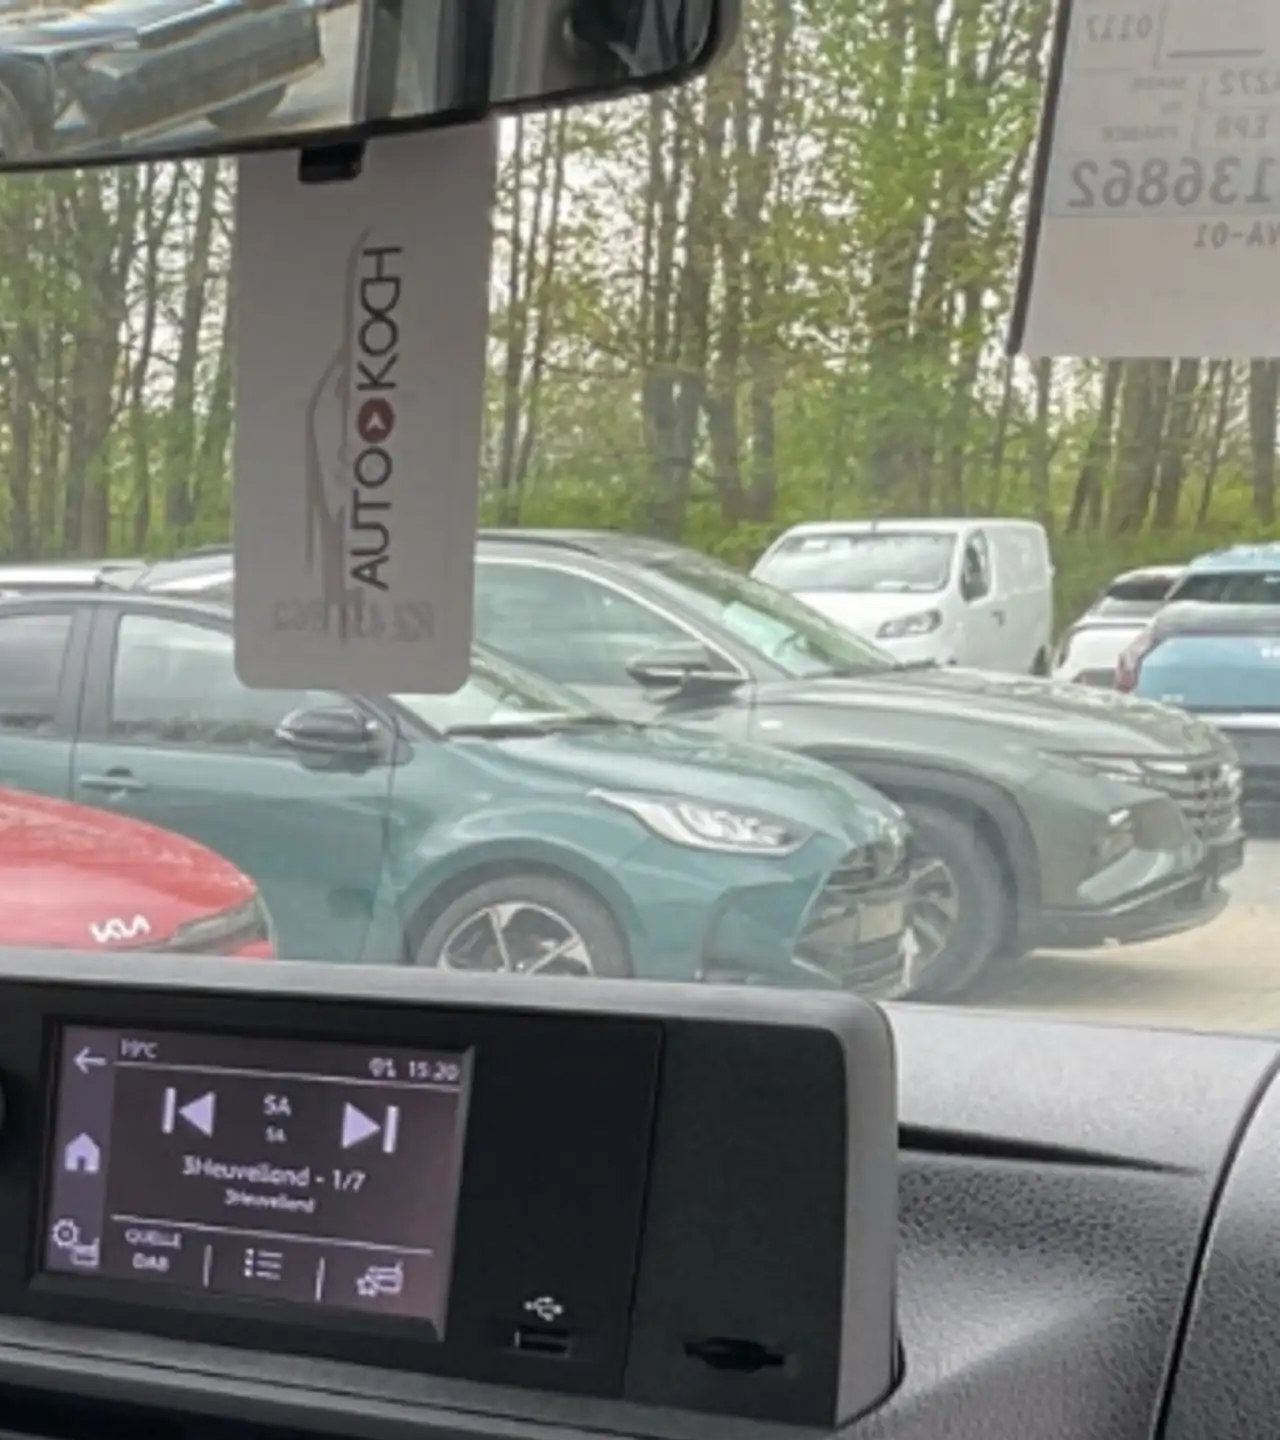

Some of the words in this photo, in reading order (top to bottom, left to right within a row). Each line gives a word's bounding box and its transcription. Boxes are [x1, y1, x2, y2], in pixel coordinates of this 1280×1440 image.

[356, 245, 403, 391] KOCH
[351, 447, 393, 591] AUTO
[408, 1060, 460, 1082] 15:20
[332, 1168, 366, 1192] 1/7
